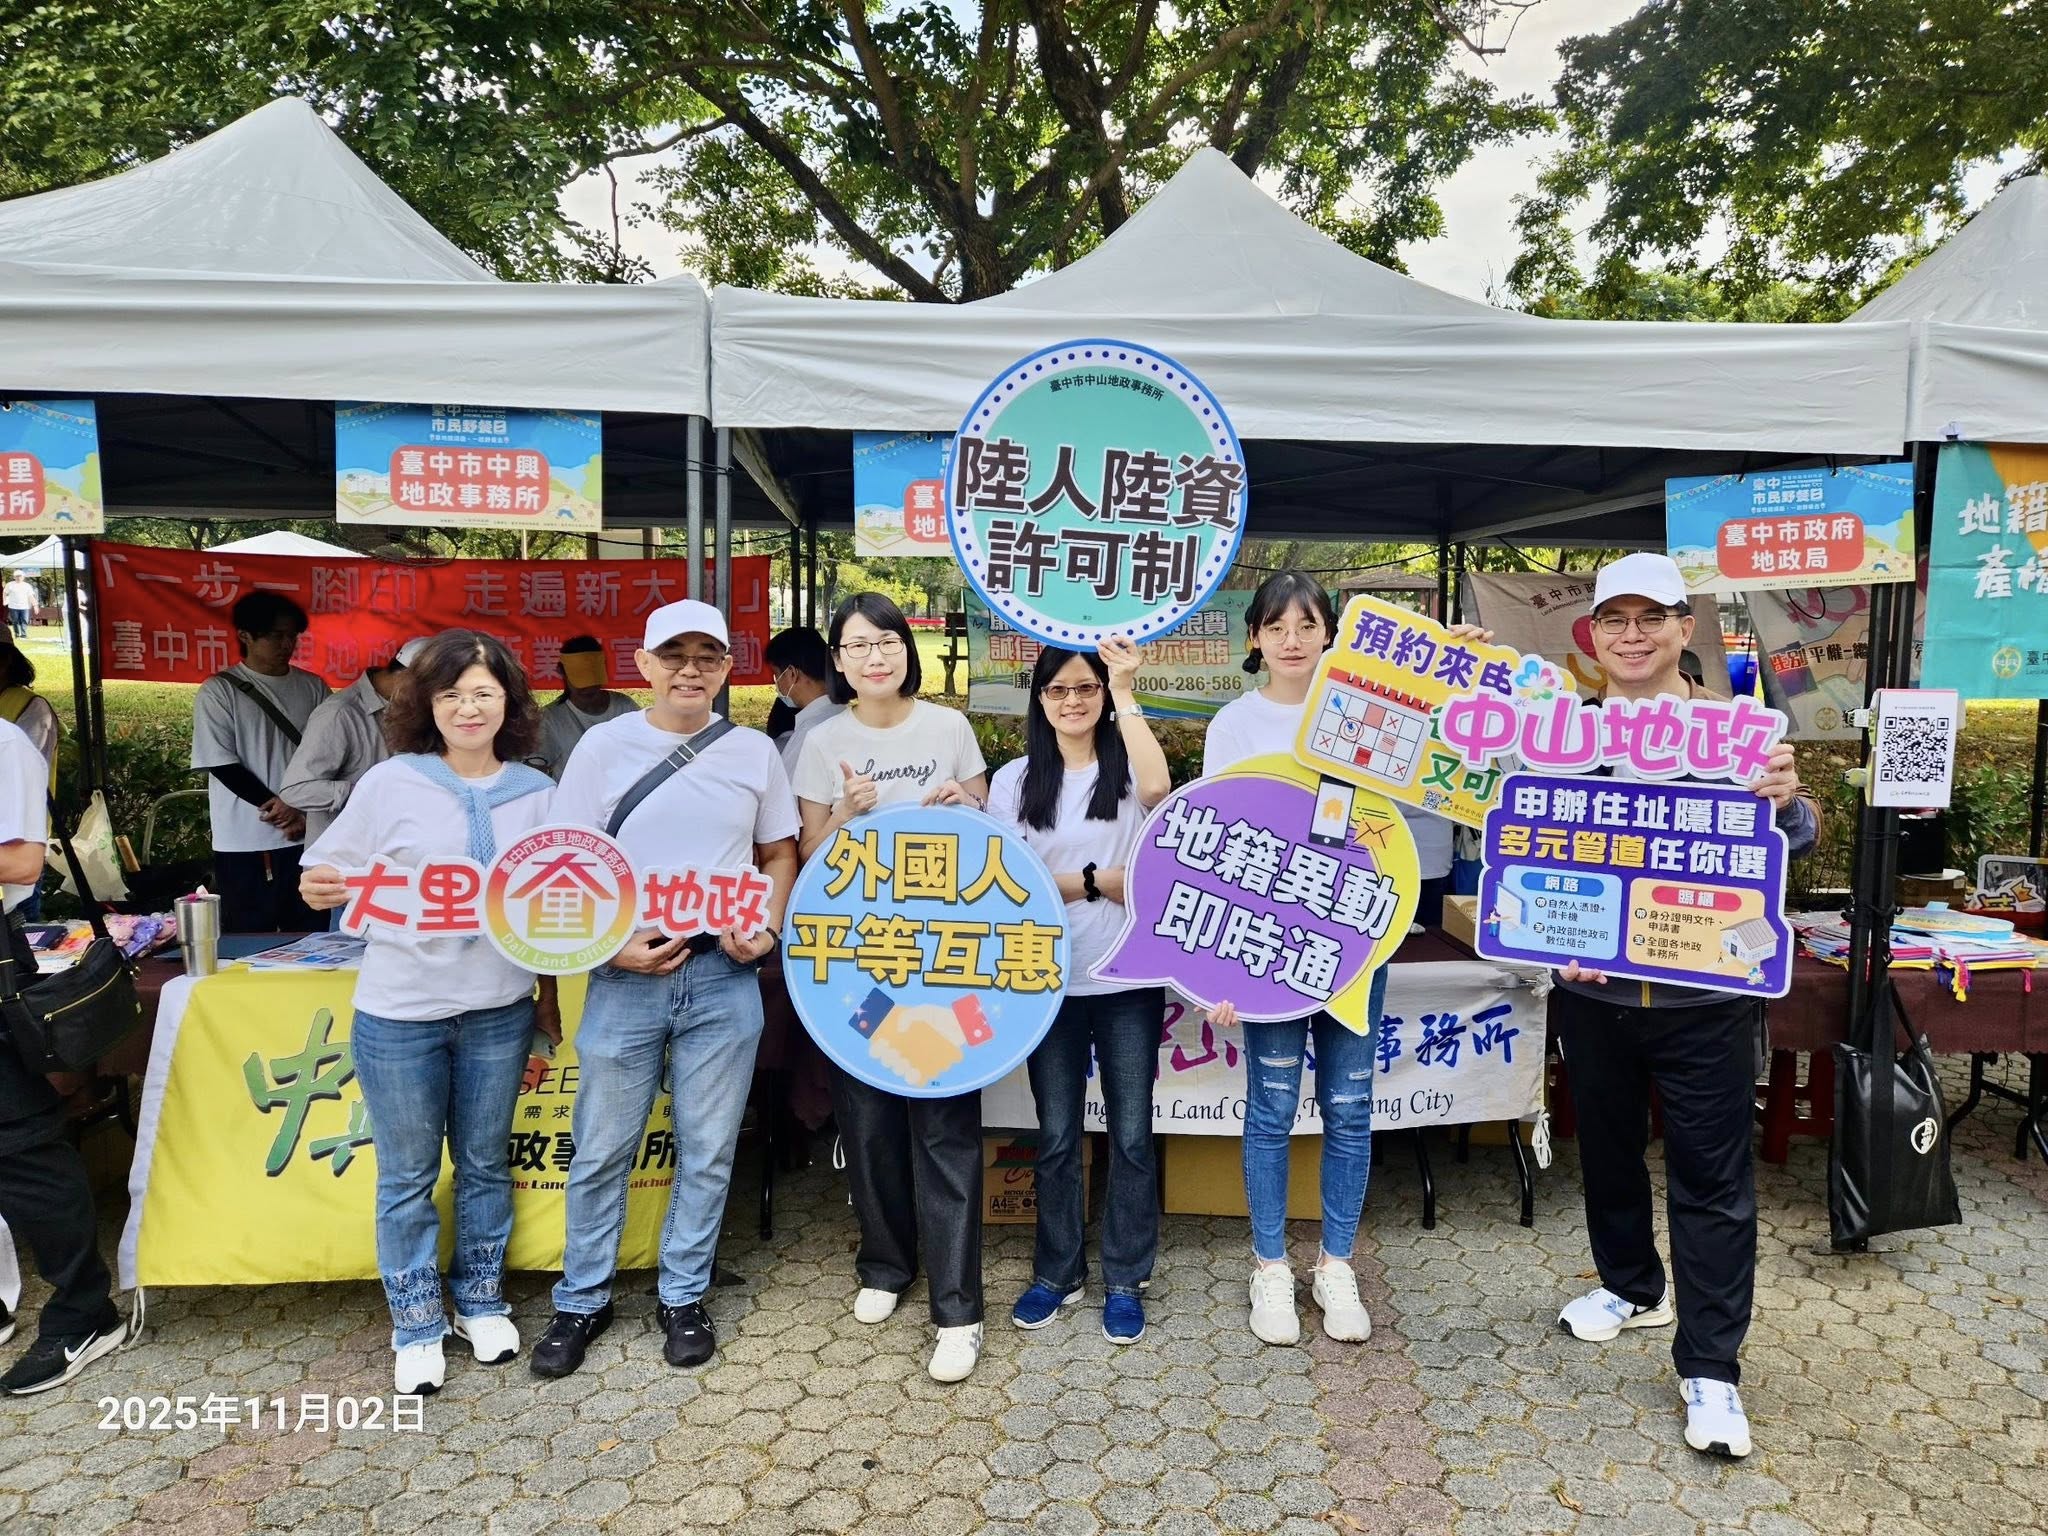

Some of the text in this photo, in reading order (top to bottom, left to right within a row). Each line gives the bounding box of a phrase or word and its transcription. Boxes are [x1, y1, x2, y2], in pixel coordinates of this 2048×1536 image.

[1049, 374, 1165, 401] 臺中市中山地政事務所
[0, 458, 34, 483] 里
[400, 450, 540, 480] 臺中市中興
[400, 481, 540, 511] 地政事務所
[913, 485, 944, 509] 臺
[955, 435, 1243, 530] 陸人陸資
[1752, 488, 1824, 505] 市民野餐日
[1959, 480, 2048, 536] 地籍
[1724, 517, 1855, 548] 臺中市政府
[986, 520, 1199, 603] 許可制
[1751, 547, 1828, 573] 地政局
[463, 569, 760, 618] 走遍新大」
[1444, 693, 1777, 777] 中山地政
[1513, 786, 1757, 838] 申辦住址隱匿
[498, 831, 630, 878] 臺中市大里地政事務所
[824, 828, 1030, 907] 外國人
[1155, 797, 1399, 940] 地籍異動
[1498, 825, 1767, 880] 多元管道任你選
[344, 862, 768, 933] 大里 地政
[1545, 875, 1579, 892] 網路
[1154, 880, 1342, 1002] 即時通
[1647, 936, 1702, 952] 全國各地政
[1648, 922, 1681, 934] 申請書
[502, 932, 618, 968] Dali Land Office
[788, 913, 1063, 992] 平等互惠
[1647, 948, 1679, 960] 事務所
[1170, 1096, 1225, 1120] Land
[1409, 1088, 1454, 1116] City
[992, 1197, 1008, 1209] A4
